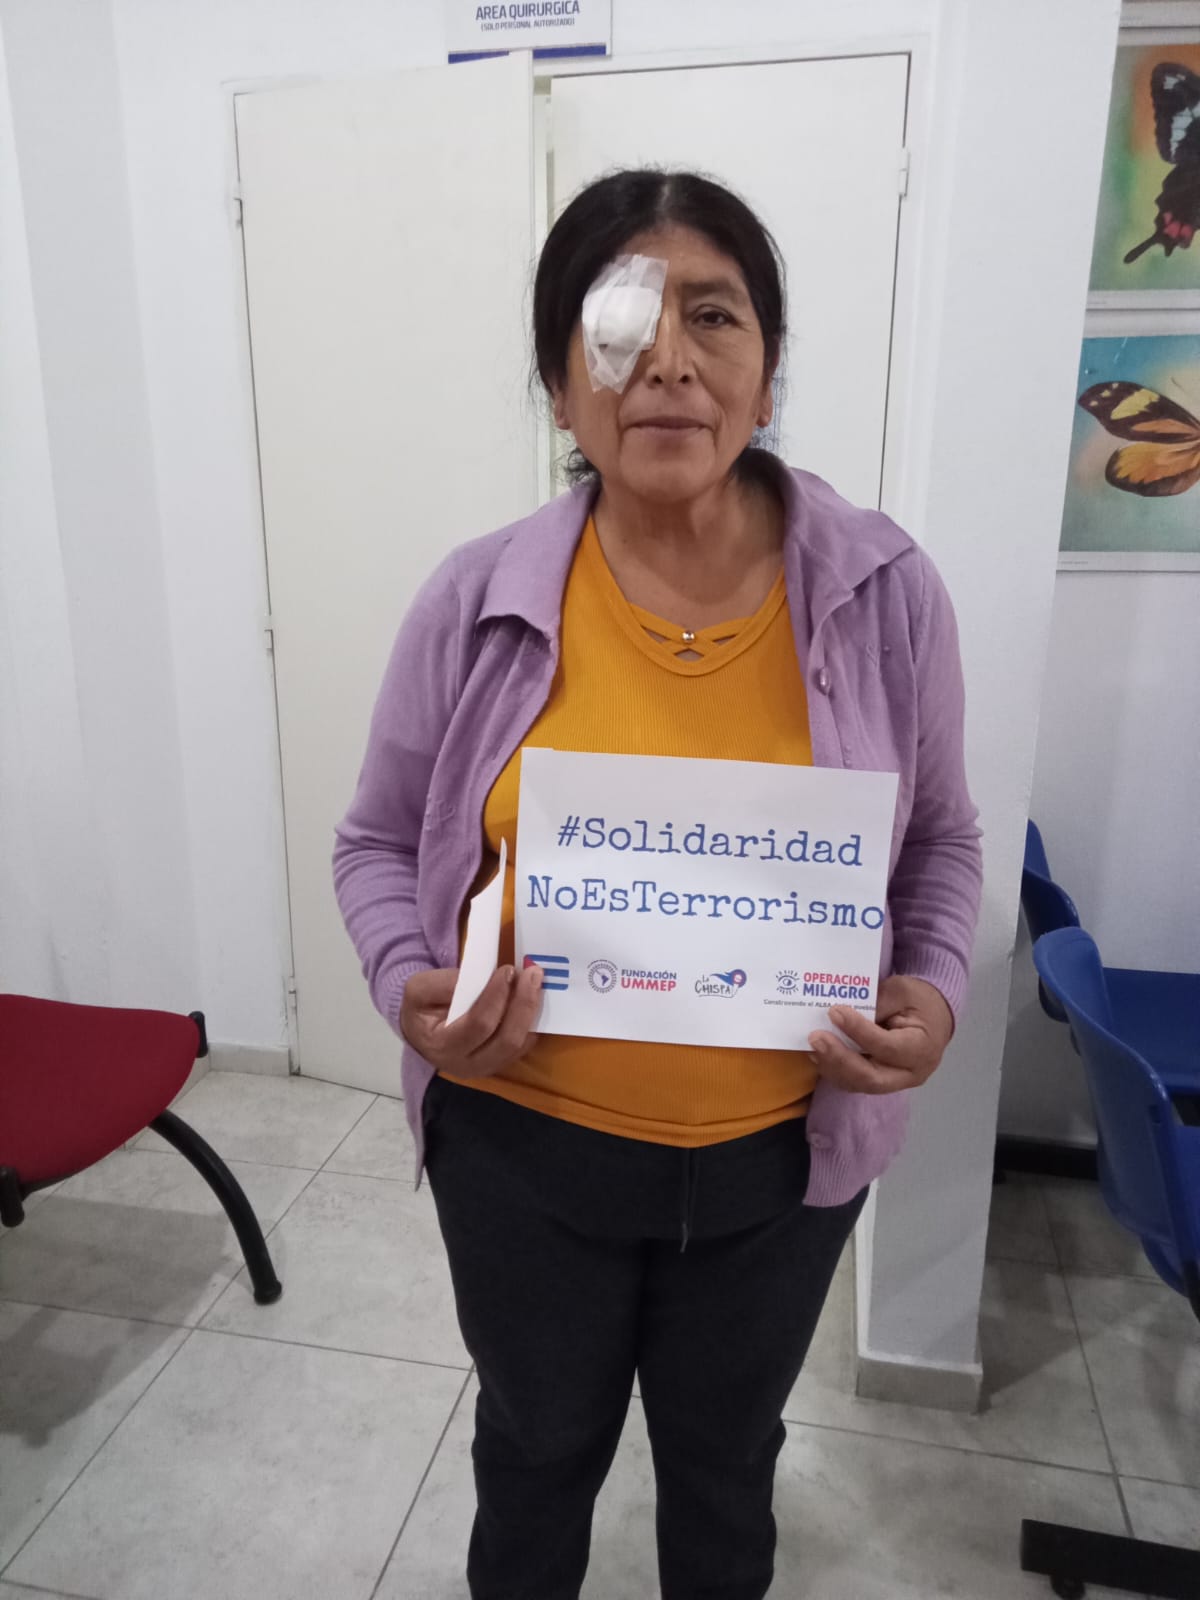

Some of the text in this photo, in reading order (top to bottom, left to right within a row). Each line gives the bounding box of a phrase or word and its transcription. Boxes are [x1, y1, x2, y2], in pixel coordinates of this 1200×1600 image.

[475, 0, 580, 21] AREA QUIRURGICA
[557, 815, 863, 867] #Solidaridad
[526, 874, 885, 930] NoEsTerrorismo
[621, 968, 677, 980] FUNDACIÓN
[803, 972, 871, 986] OPERACION
[620, 977, 677, 992] UMMEP
[694, 980, 731, 995] CHISPA
[803, 983, 870, 1000] MILAGRO
